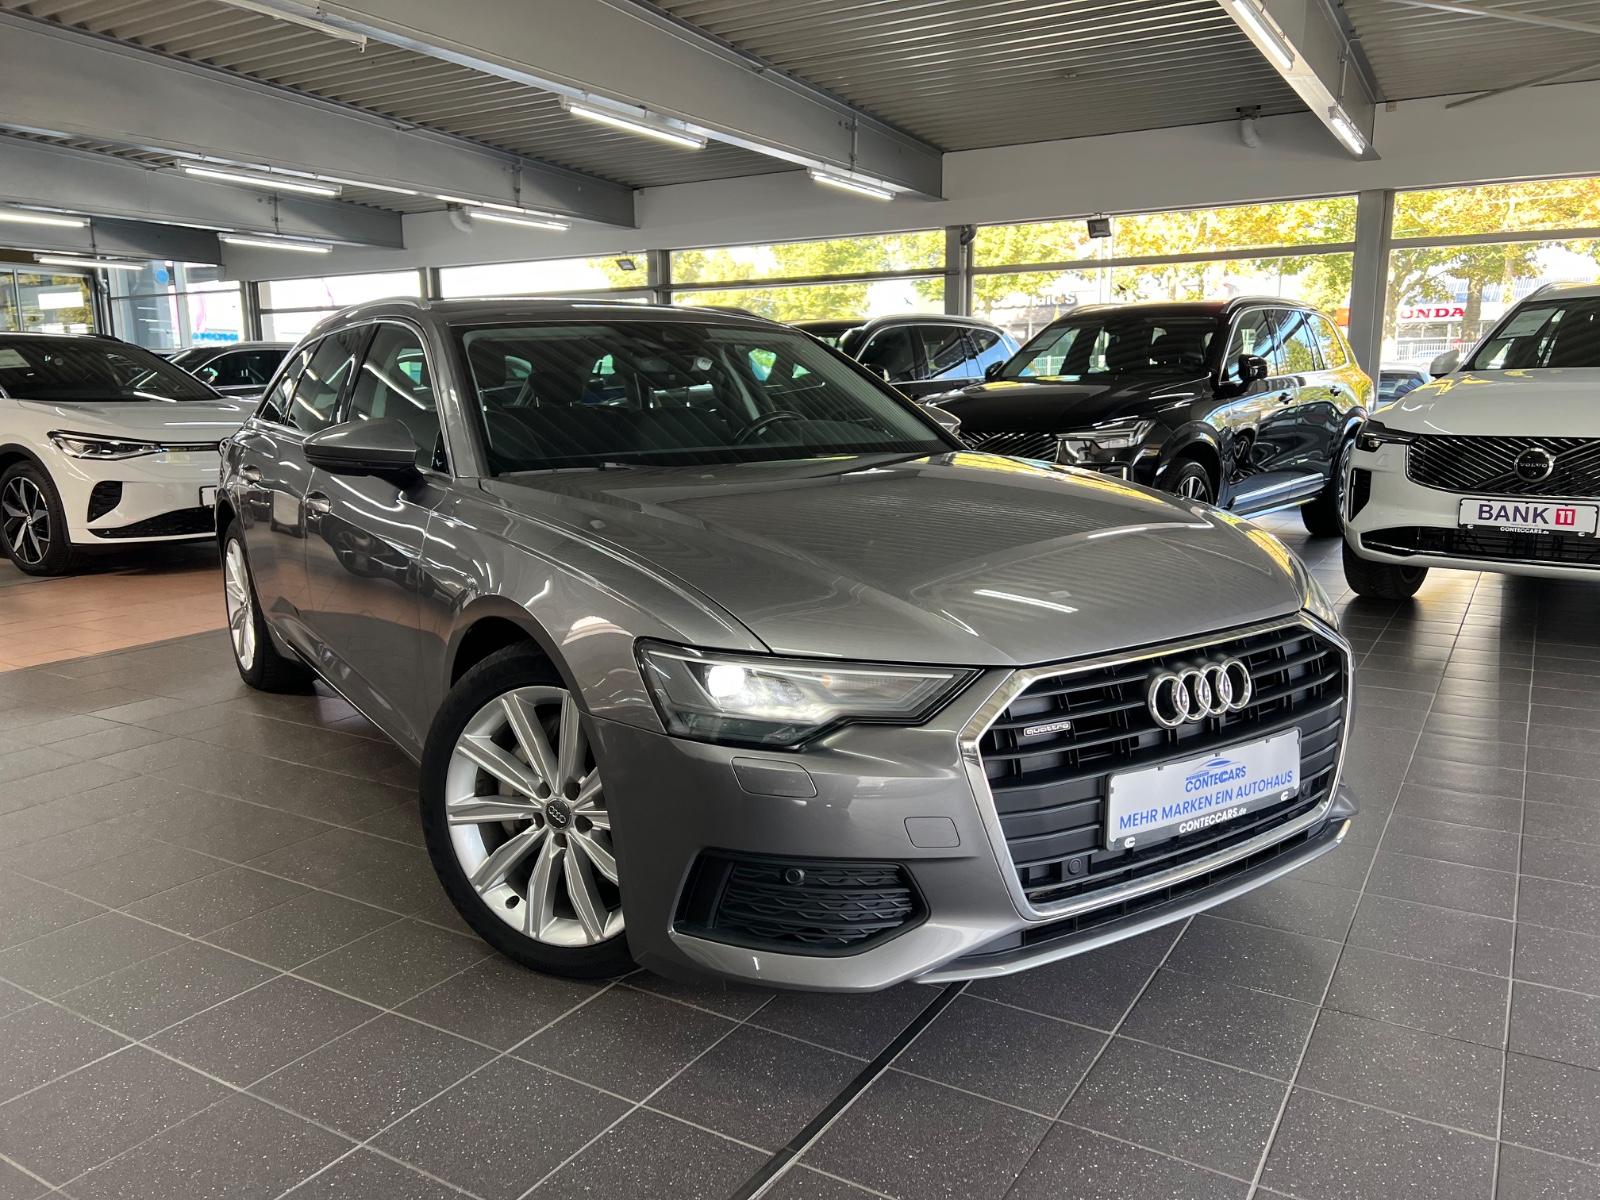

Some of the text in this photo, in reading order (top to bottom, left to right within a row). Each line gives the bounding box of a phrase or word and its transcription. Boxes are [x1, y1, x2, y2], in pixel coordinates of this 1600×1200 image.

[1401, 307, 1466, 319] ONDA
[1478, 503, 1574, 525] BANK 11
[1025, 722, 1069, 736] quattro
[1120, 770, 1293, 830] MEHR MARKEN EIN AUTOHAUS
[1179, 806, 1247, 834] CONTECCARS.de
